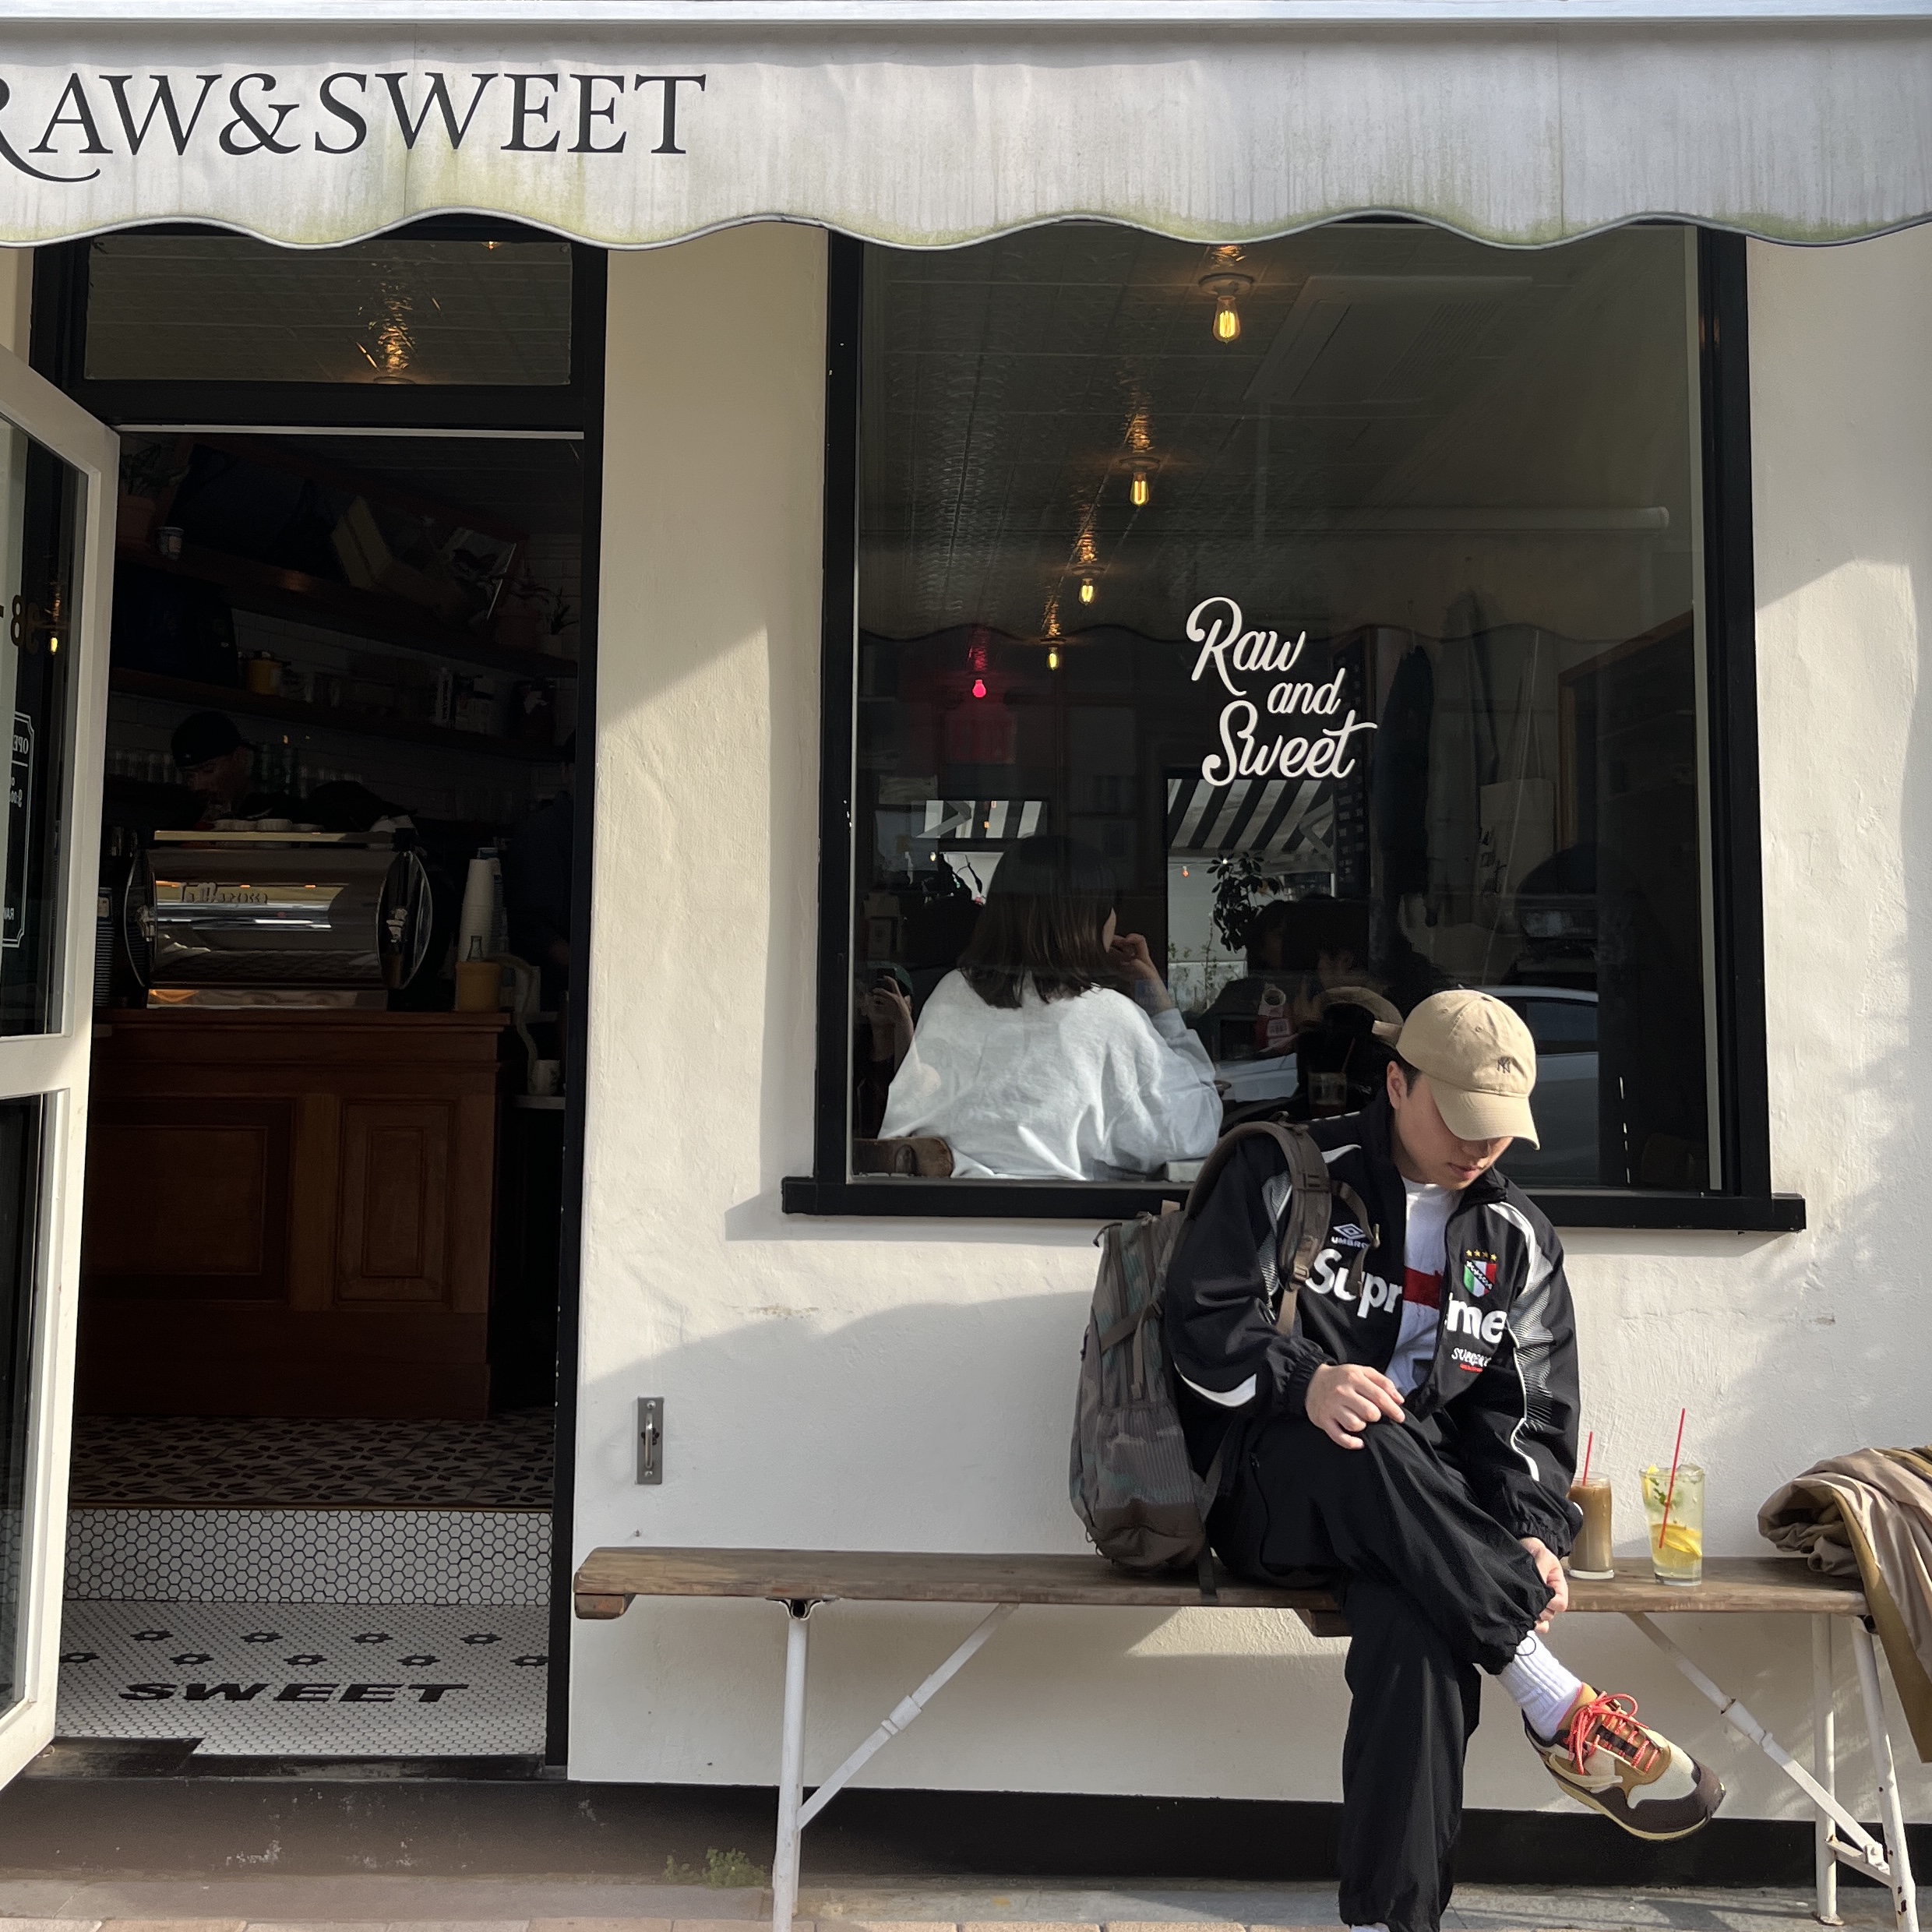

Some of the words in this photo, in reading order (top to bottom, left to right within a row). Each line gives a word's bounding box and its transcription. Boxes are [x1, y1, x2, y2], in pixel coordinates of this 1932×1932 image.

[1186, 597, 1306, 696] Raw
[1267, 668, 1345, 714] and
[1201, 700, 1378, 786] Sweet
[118, 1682, 470, 1703] SWEET
